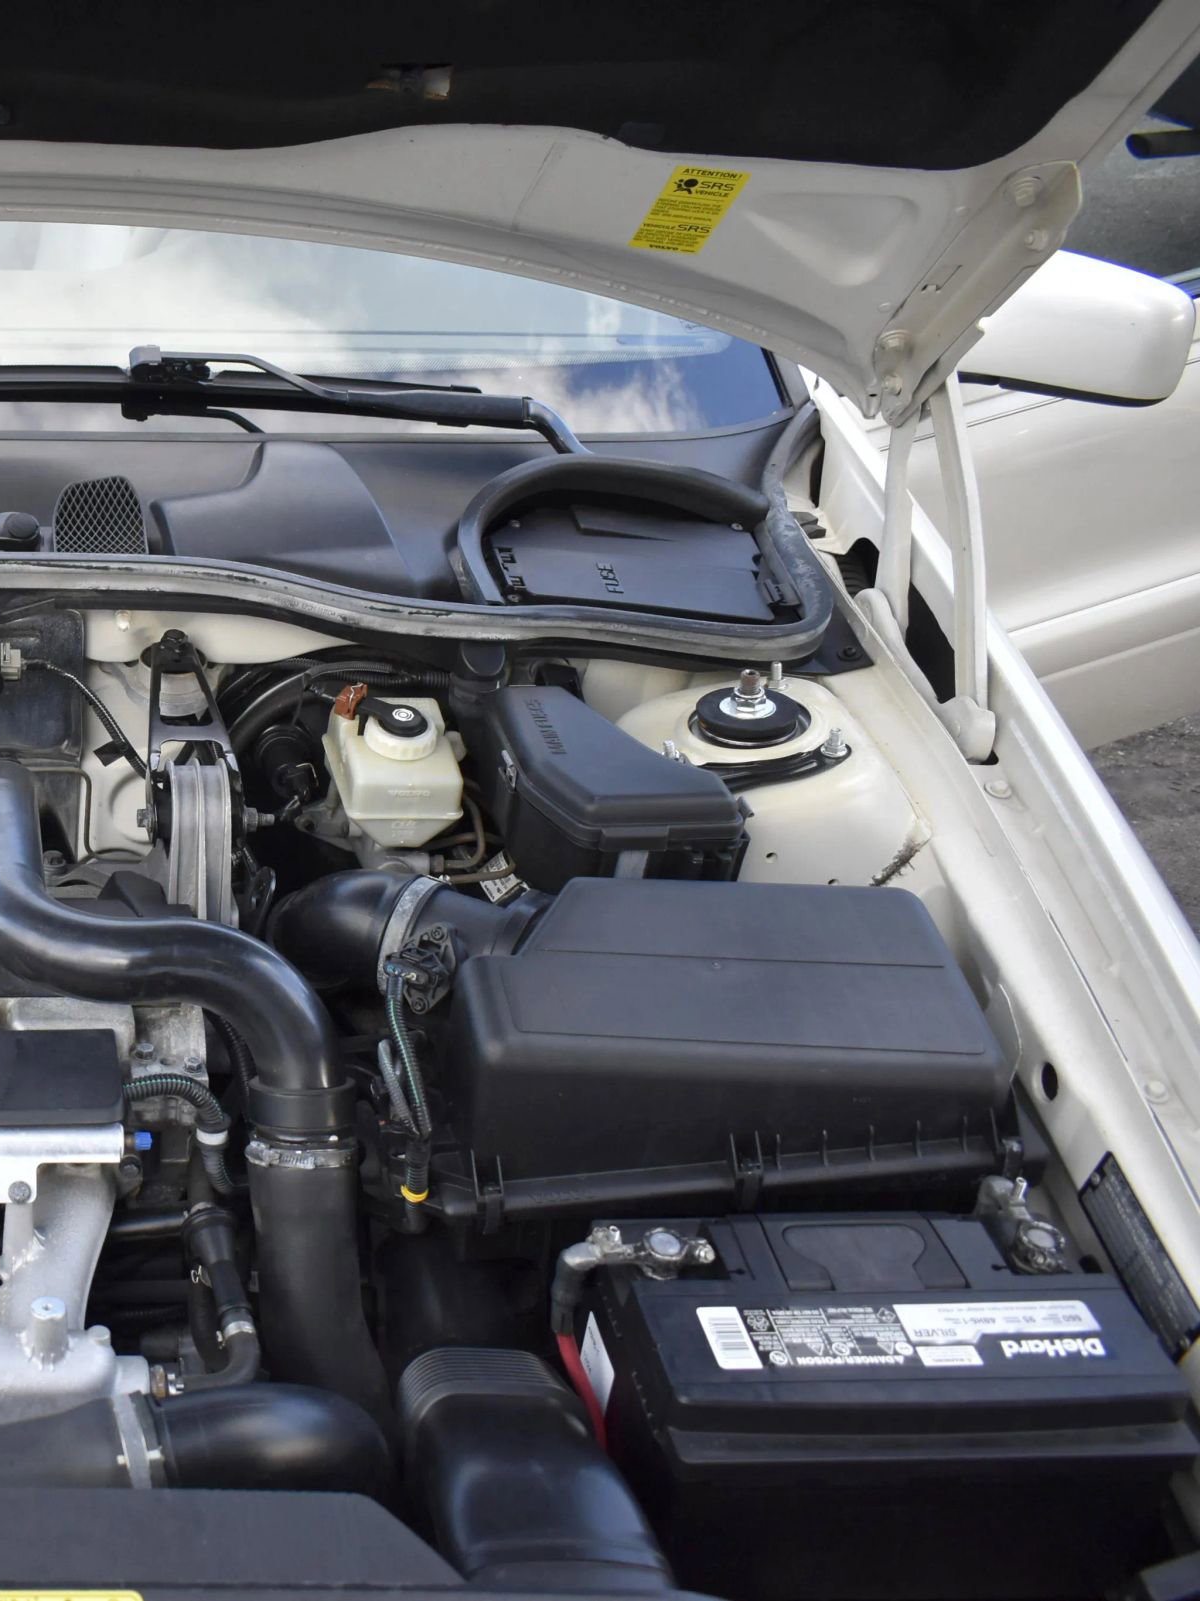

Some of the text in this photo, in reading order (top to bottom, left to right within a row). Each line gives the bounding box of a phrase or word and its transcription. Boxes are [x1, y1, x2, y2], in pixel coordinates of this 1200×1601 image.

[682, 168, 737, 179] ATTENTION
[699, 180, 736, 192] SRS
[695, 190, 730, 198] VEHICLE
[677, 224, 712, 234] SRS
[596, 562, 624, 594] FUSE
[914, 1327, 958, 1338] SILVER
[1002, 1336, 1106, 1360] DieHard
[796, 1354, 896, 1365] DANGER/POISON
